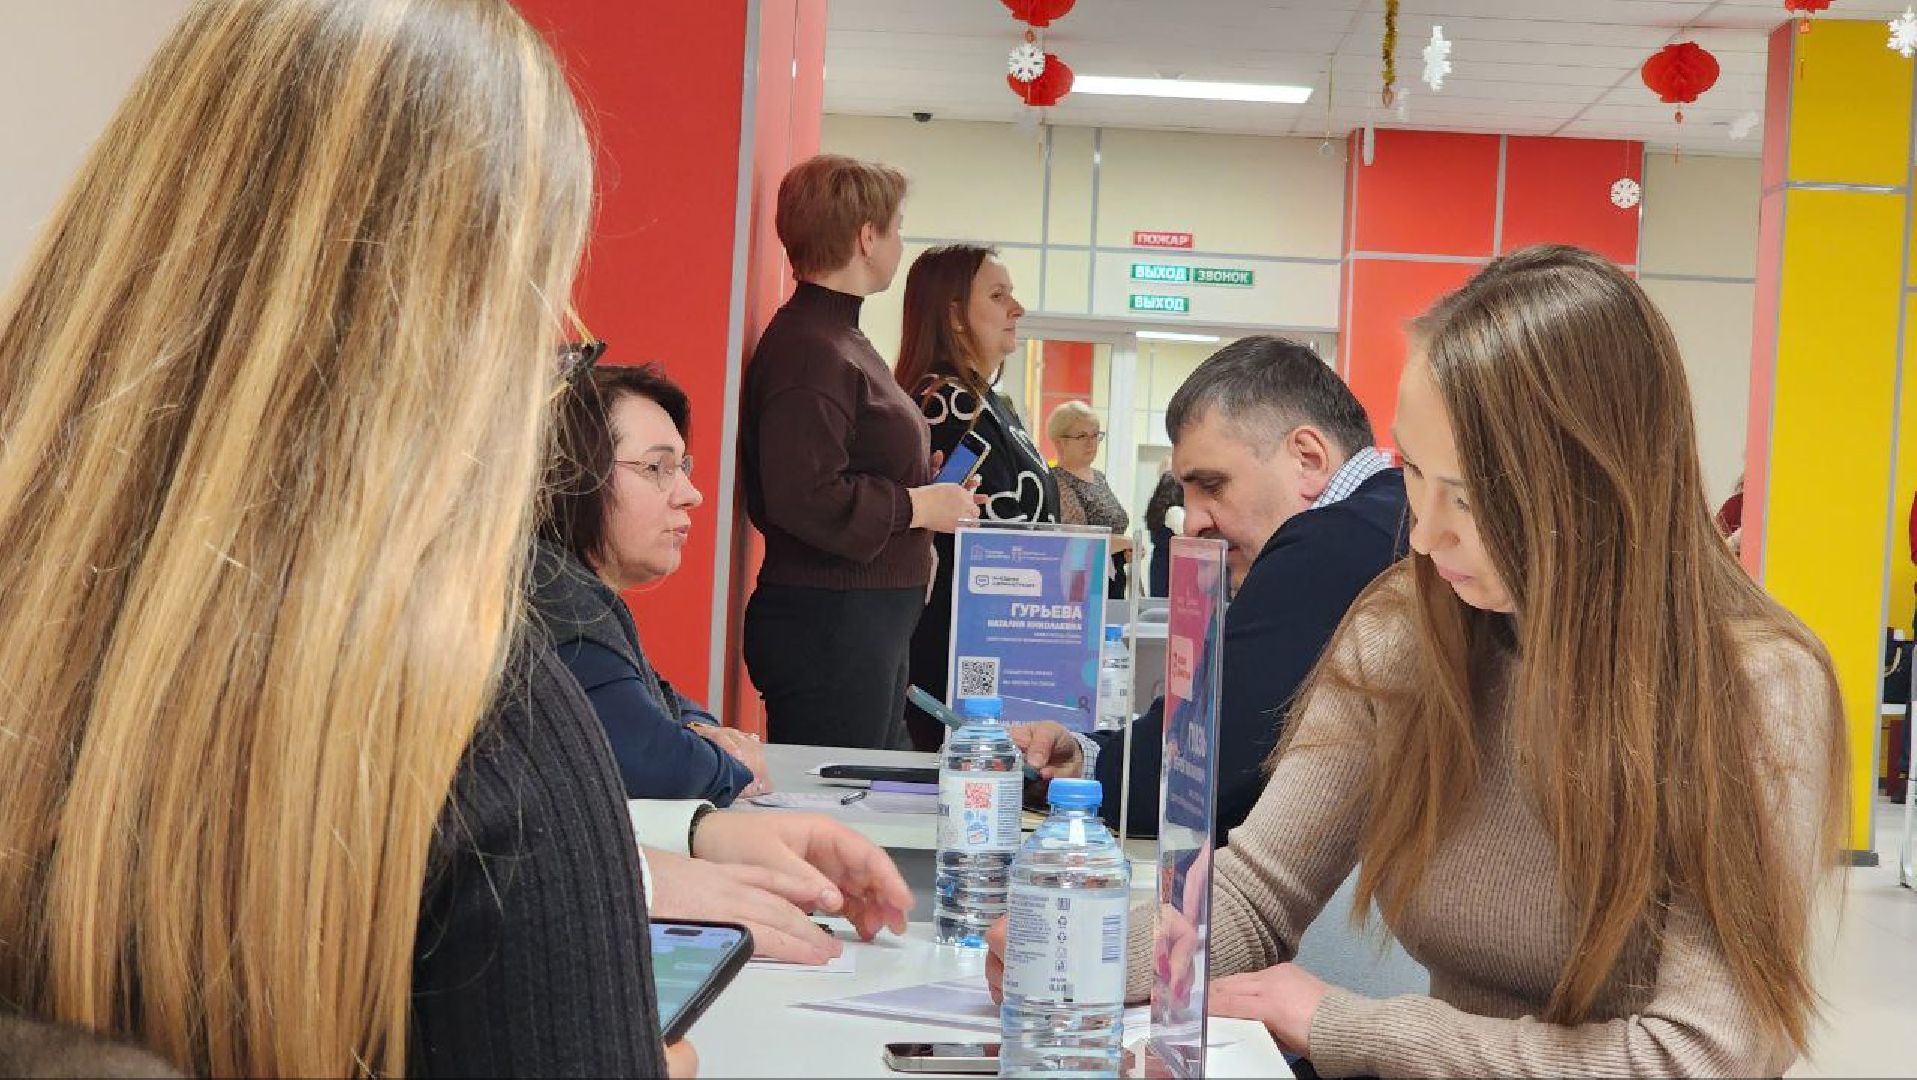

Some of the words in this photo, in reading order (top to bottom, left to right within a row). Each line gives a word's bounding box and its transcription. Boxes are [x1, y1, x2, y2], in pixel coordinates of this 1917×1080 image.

[1137, 234, 1189, 245] ПОЖАР
[1135, 266, 1186, 280] ВЫХОД
[1197, 270, 1249, 284] ЗВОНОК
[1134, 295, 1185, 311] ВЫХОД
[1011, 602, 1082, 619] ГУРЬЕВА
